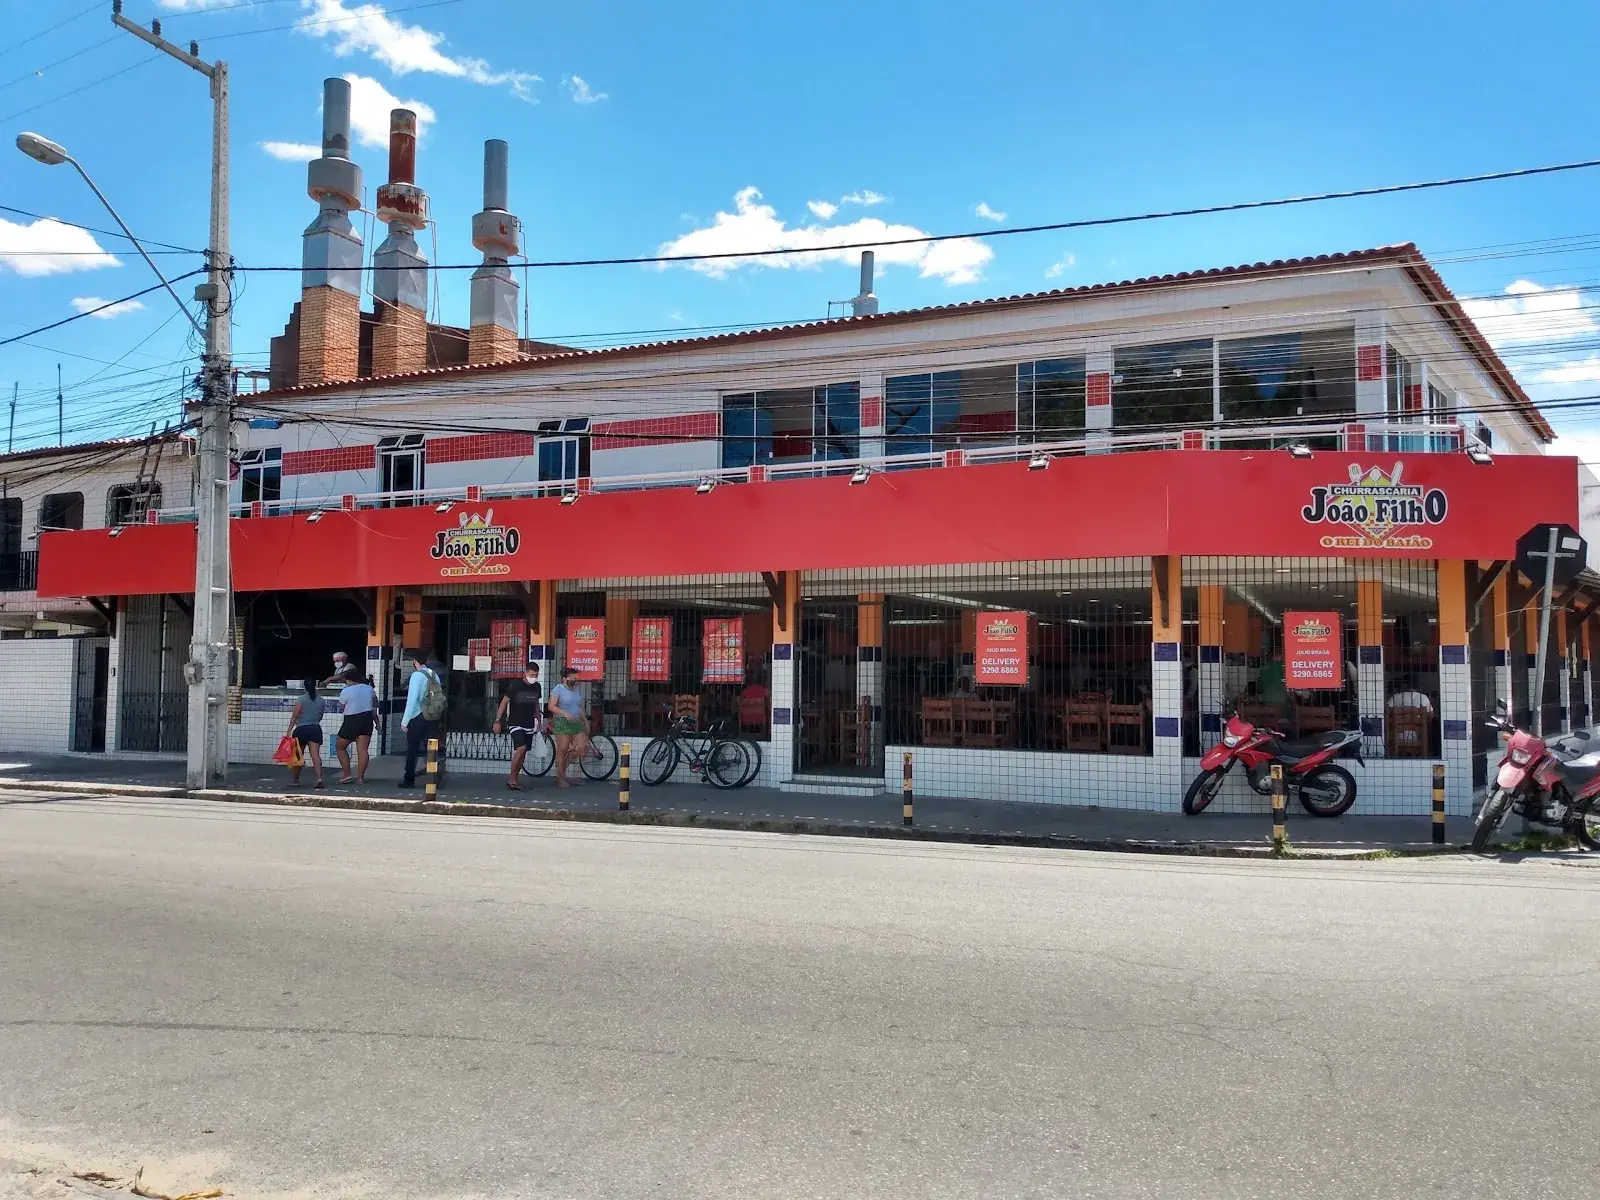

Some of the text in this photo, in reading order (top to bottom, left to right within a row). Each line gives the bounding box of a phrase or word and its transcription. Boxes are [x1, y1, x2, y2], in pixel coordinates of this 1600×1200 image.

[1333, 487, 1418, 496] CHURRASCARIA
[1303, 488, 1368, 522] João
[449, 528, 502, 537] CHURRASCARIA
[431, 533, 470, 557] João
[1323, 536, 1431, 547] O REI DO BAIÃO
[1292, 670, 1332, 678] 3290.6865
